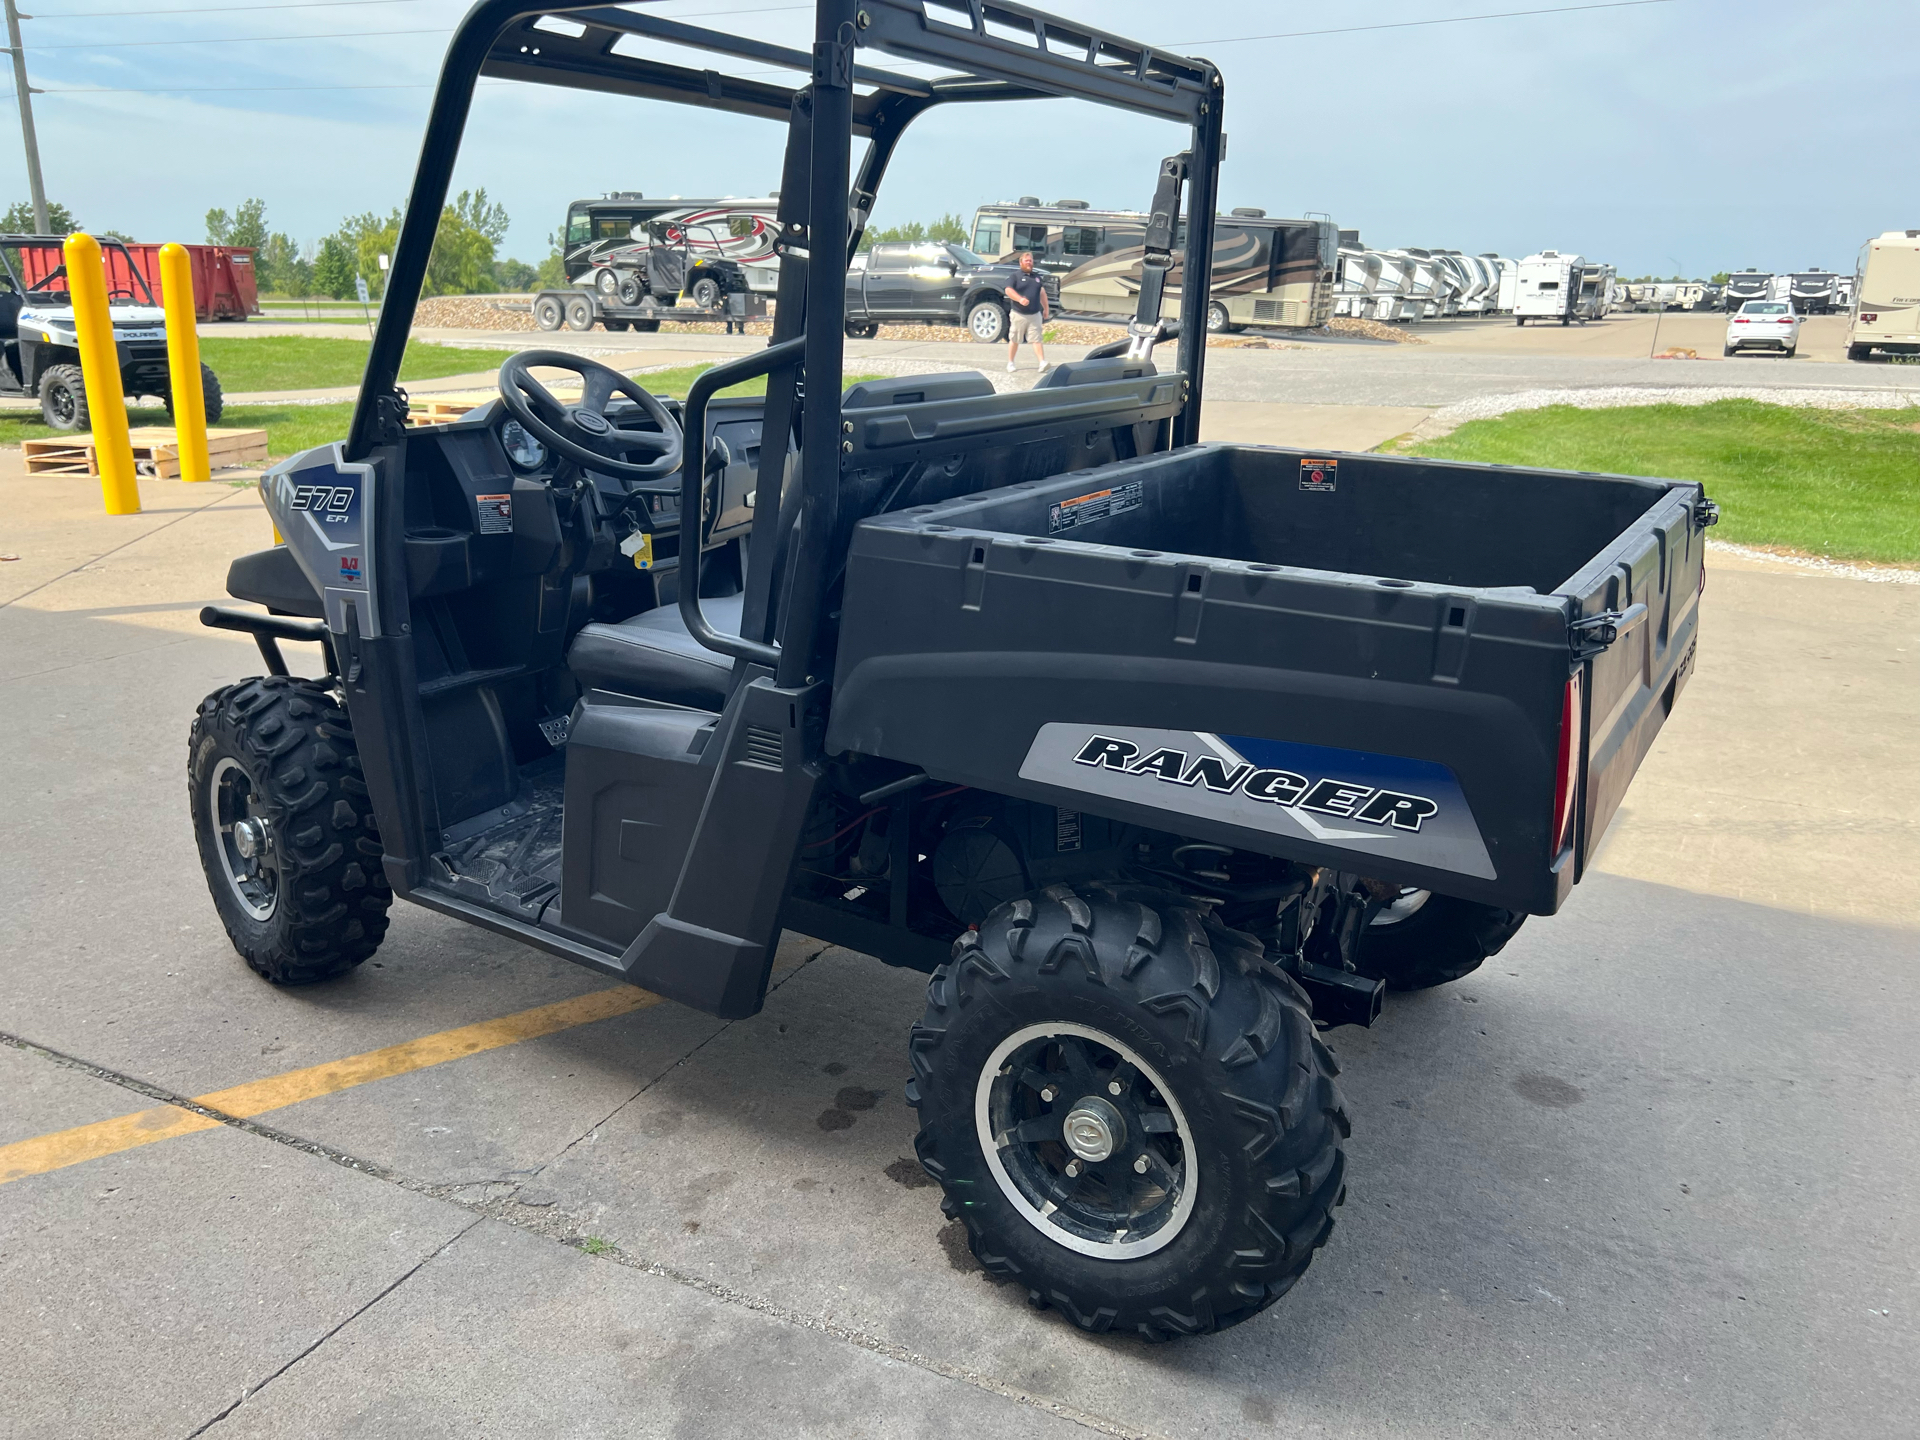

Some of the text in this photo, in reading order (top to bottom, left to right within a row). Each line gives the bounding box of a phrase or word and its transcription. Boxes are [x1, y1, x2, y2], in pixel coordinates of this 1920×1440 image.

[290, 485, 354, 512] 570
[326, 514, 349, 523] EFI
[1073, 734, 1438, 832] RANGER
